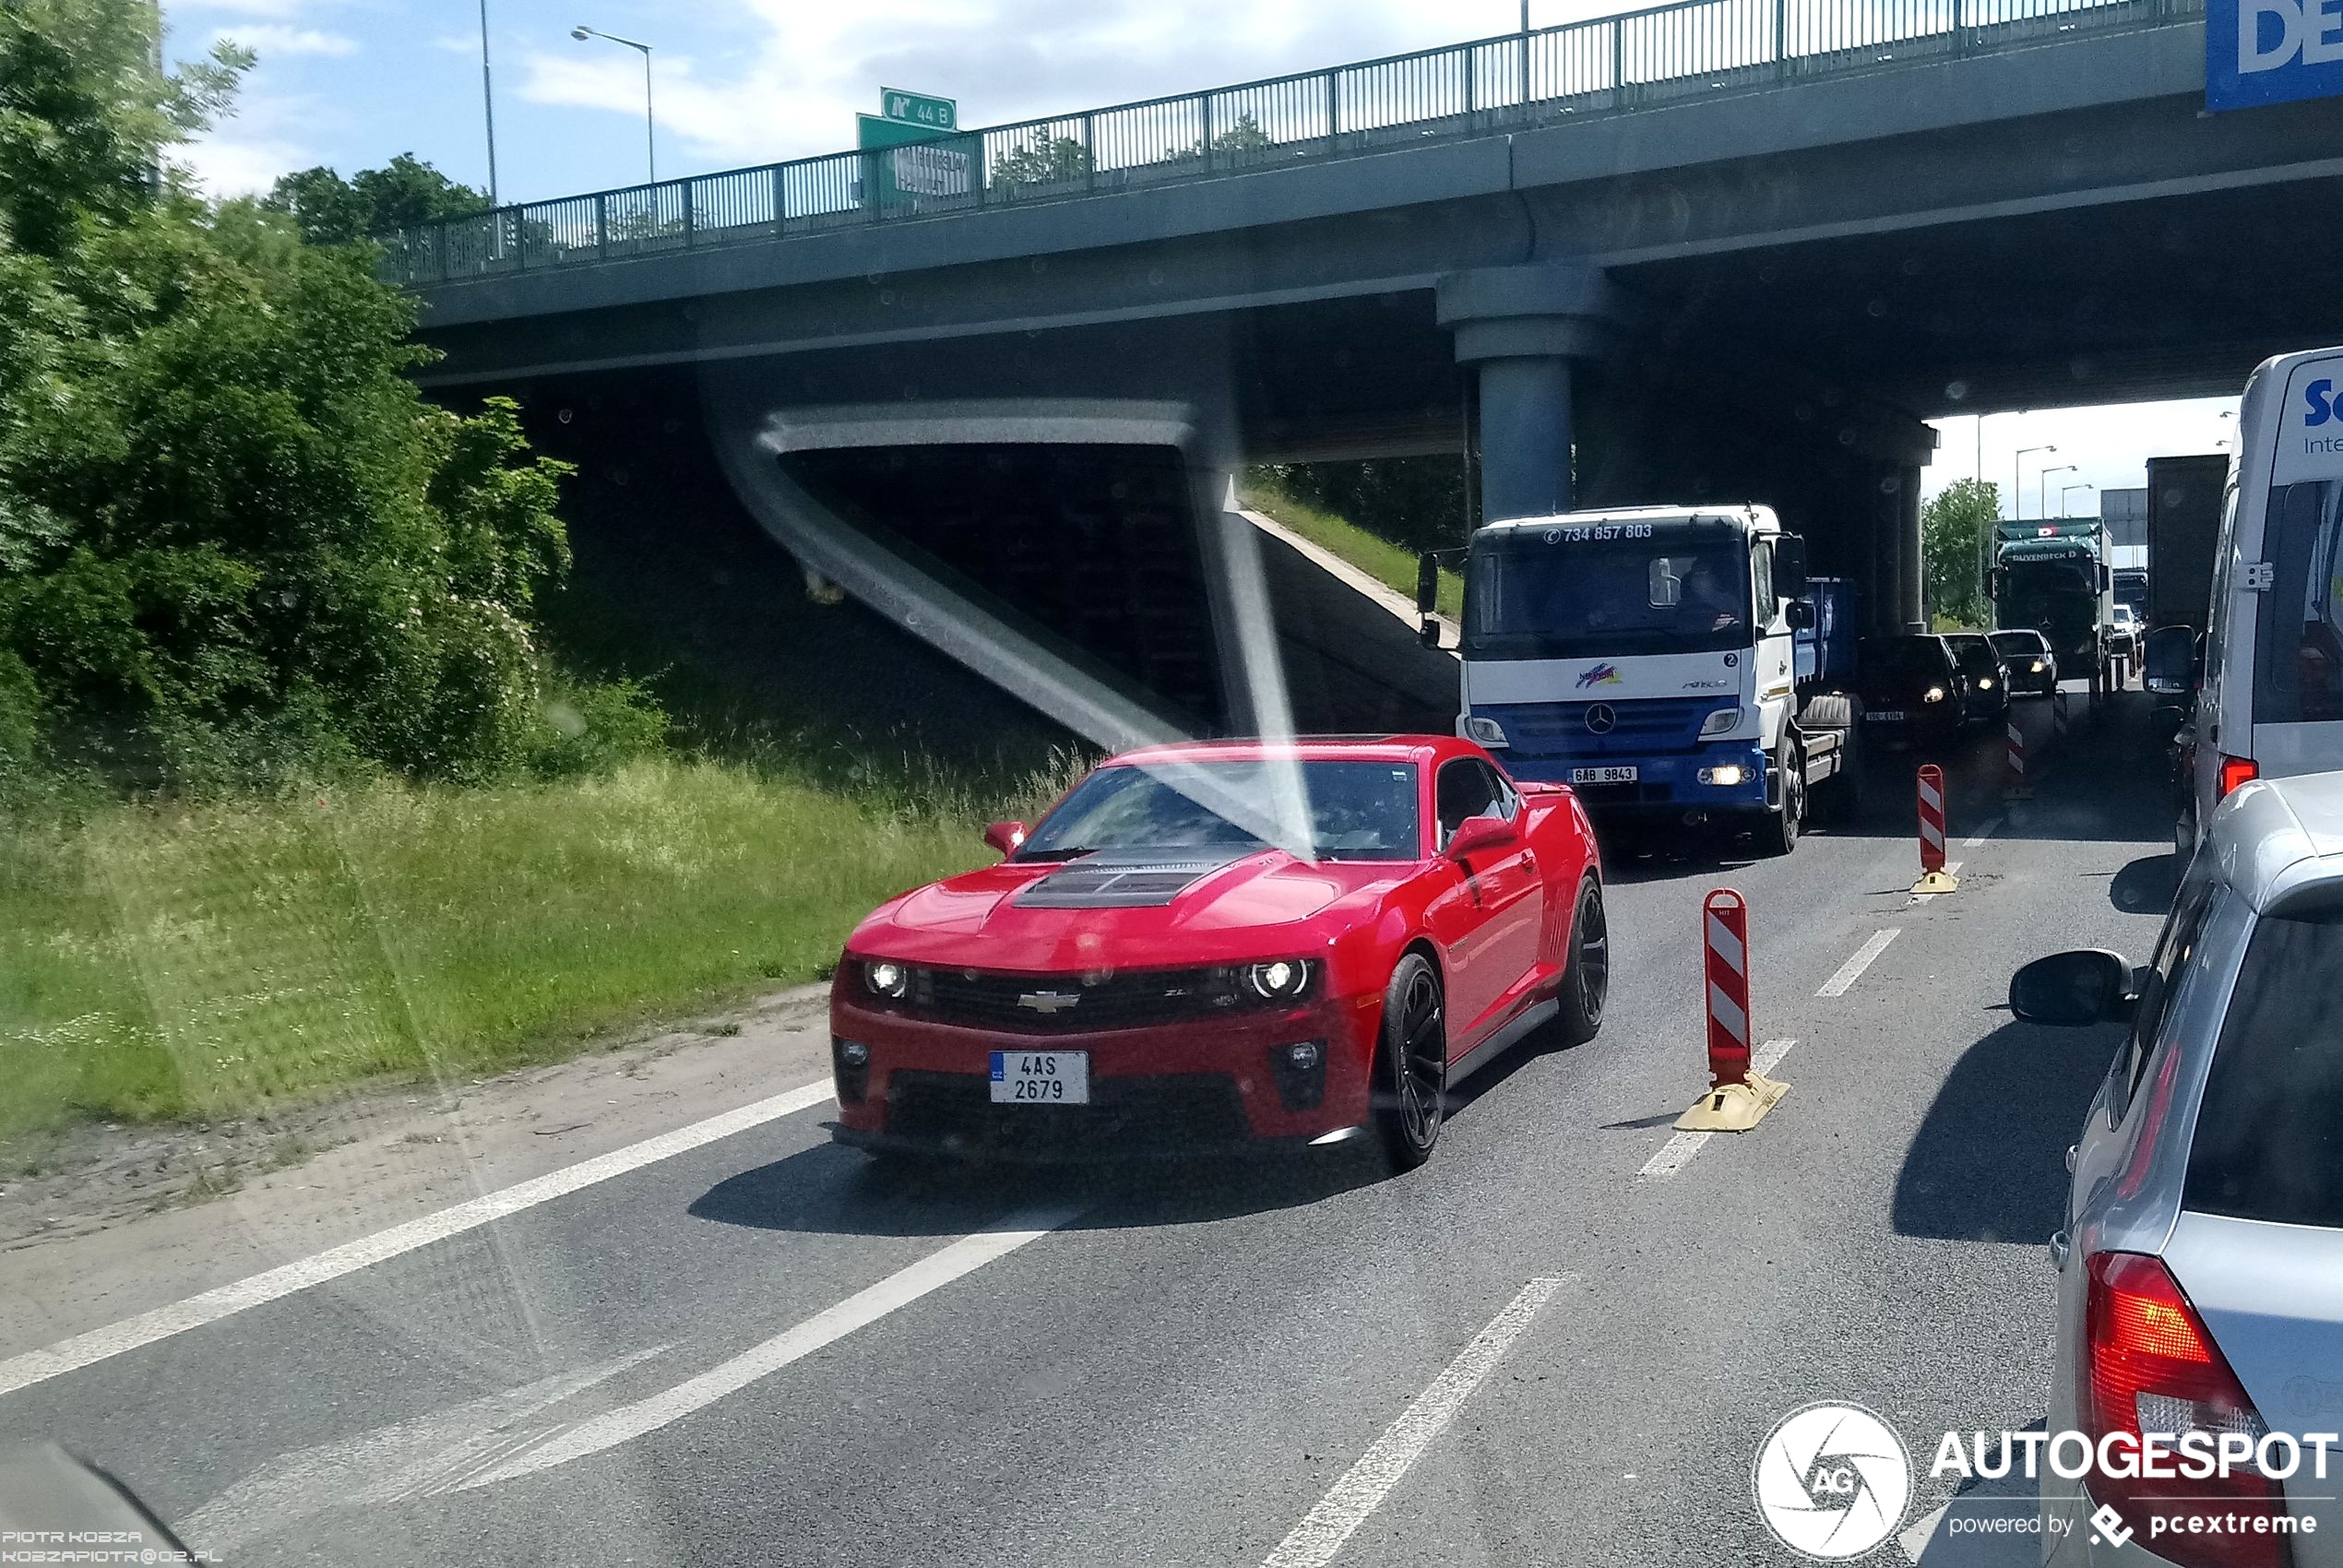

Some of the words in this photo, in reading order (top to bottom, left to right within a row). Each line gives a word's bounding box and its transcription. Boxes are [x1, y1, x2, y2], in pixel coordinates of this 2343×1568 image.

[917, 104, 933, 122] 44
[938, 108, 948, 124] B
[1564, 528, 1590, 541] 734
[1594, 526, 1621, 540] 857
[1625, 524, 1652, 538] 803
[1576, 769, 1596, 781] 6AB
[1604, 768, 1632, 780] 9843
[1021, 1056, 1056, 1075] 4AS
[1015, 1080, 1063, 1099] 2679
